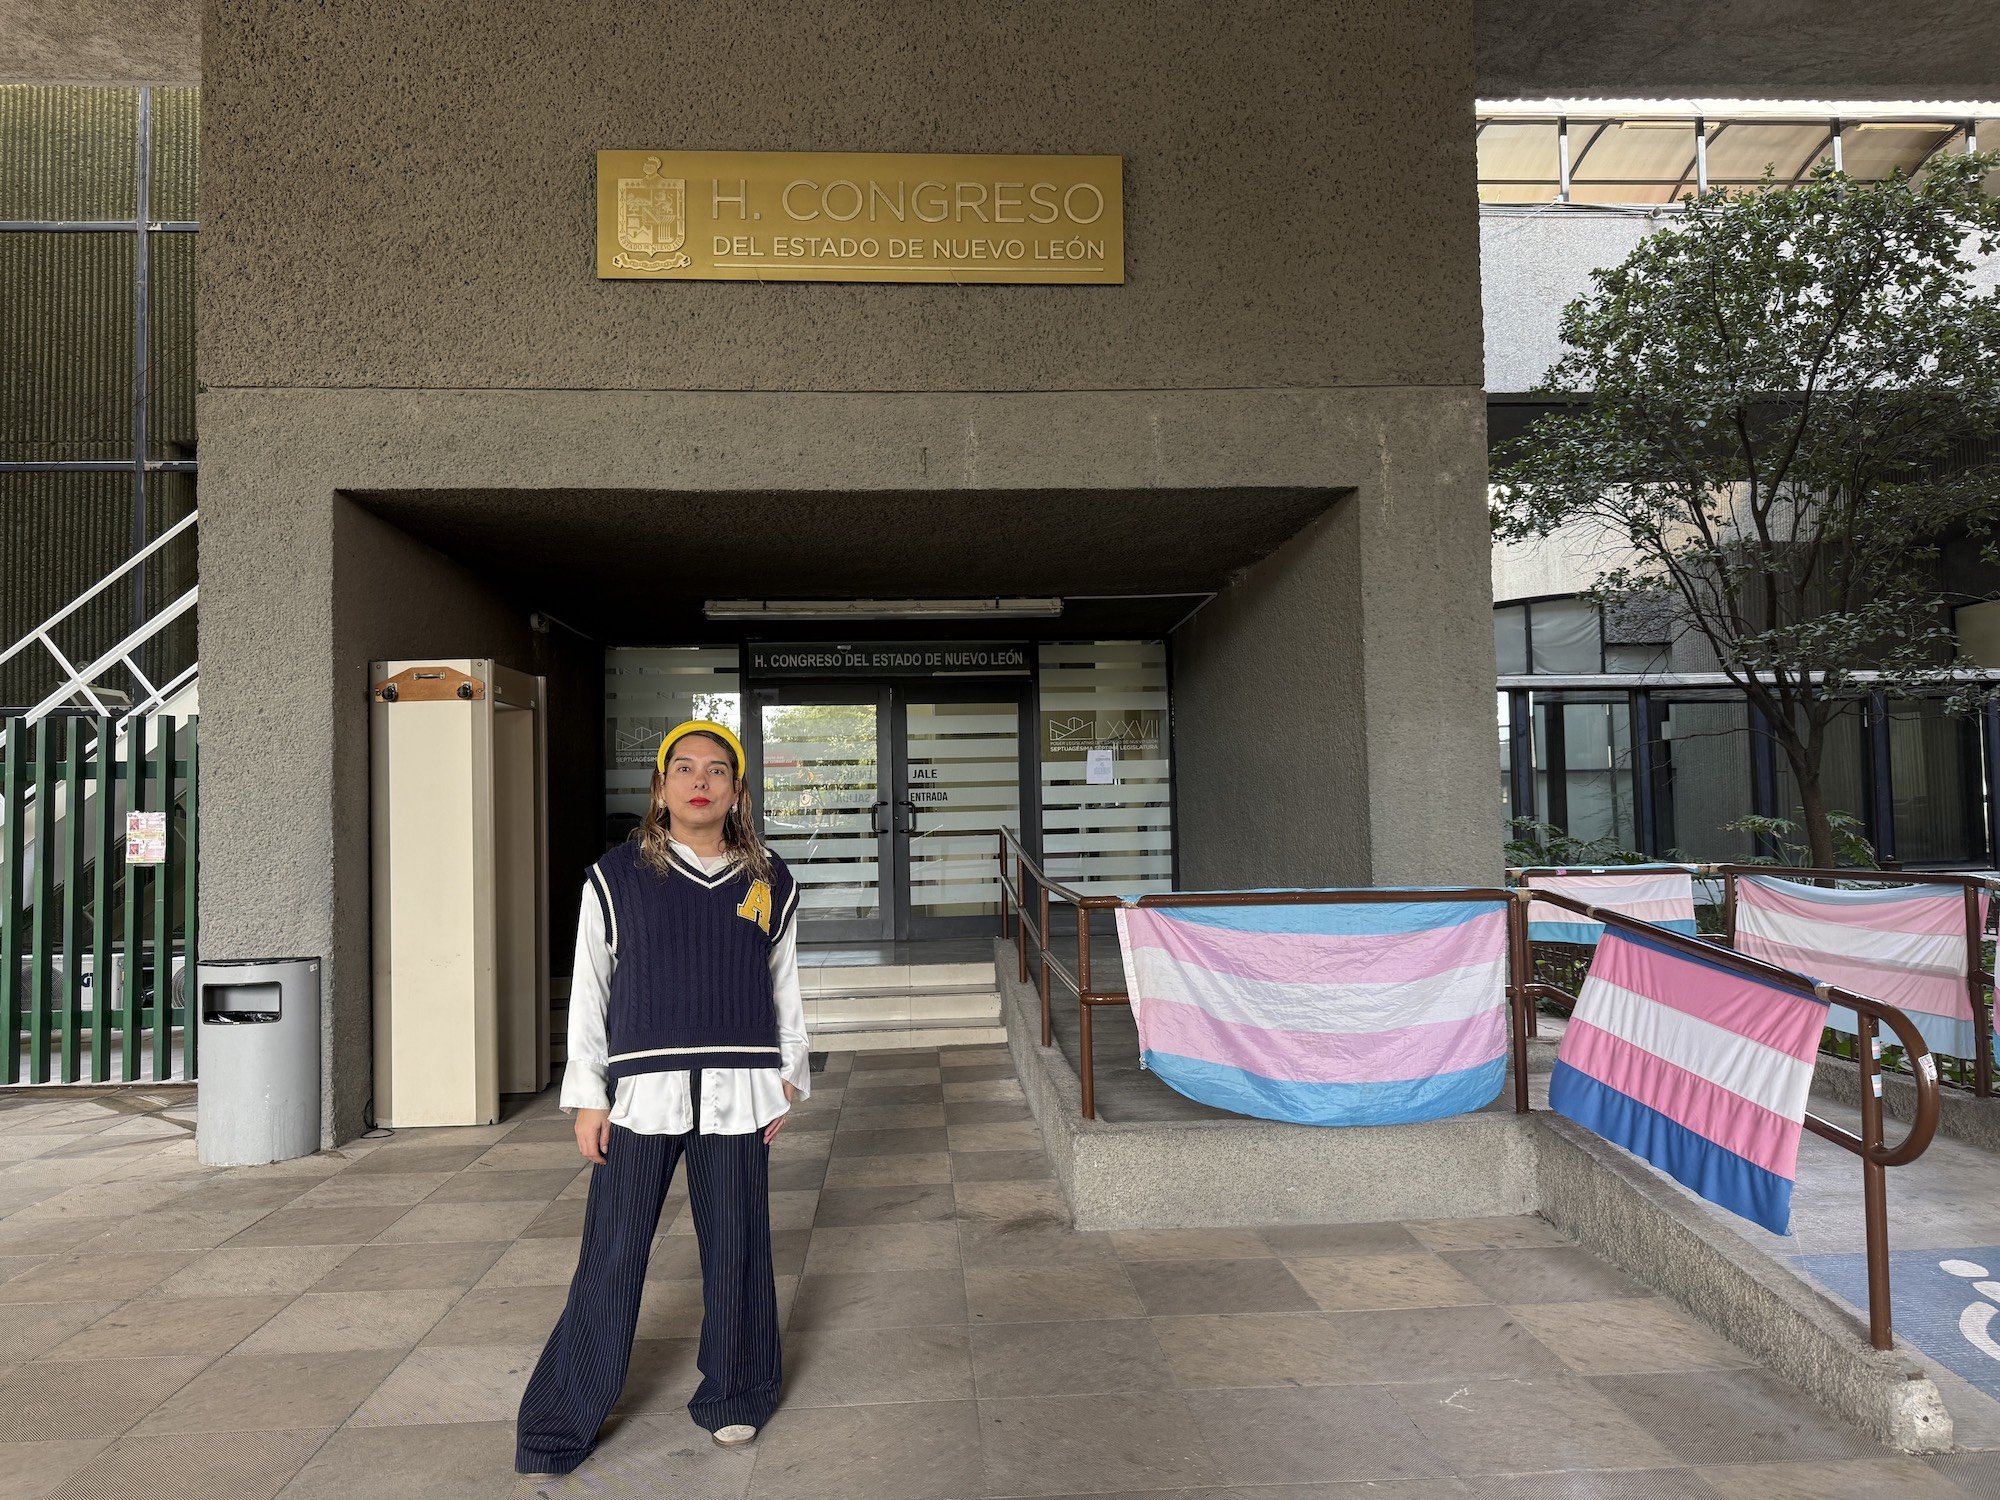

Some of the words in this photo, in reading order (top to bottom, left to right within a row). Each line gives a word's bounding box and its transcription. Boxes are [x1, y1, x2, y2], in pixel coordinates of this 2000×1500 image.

[713, 179, 761, 220] H.
[782, 179, 1104, 224] CONGRESO
[713, 236, 765, 256] DEL
[773, 237, 880, 259] ESTADO
[889, 238, 924, 259] DE
[933, 239, 1025, 260] NUEVO
[1034, 235, 1105, 260] LEÓN
[754, 654, 767, 668] H.
[770, 653, 841, 668] CONGRESO
[845, 653, 869, 667] DEL
[872, 653, 922, 667] ESTADO
[925, 652, 941, 666] DE
[945, 652, 987, 665] NUEVO
[991, 649, 1023, 665] LEÓN
[1120, 743, 1159, 751] LEGISLATURA
[912, 769, 938, 779] JALE
[910, 792, 948, 802] ENTRADA
[737, 878, 772, 936] A
